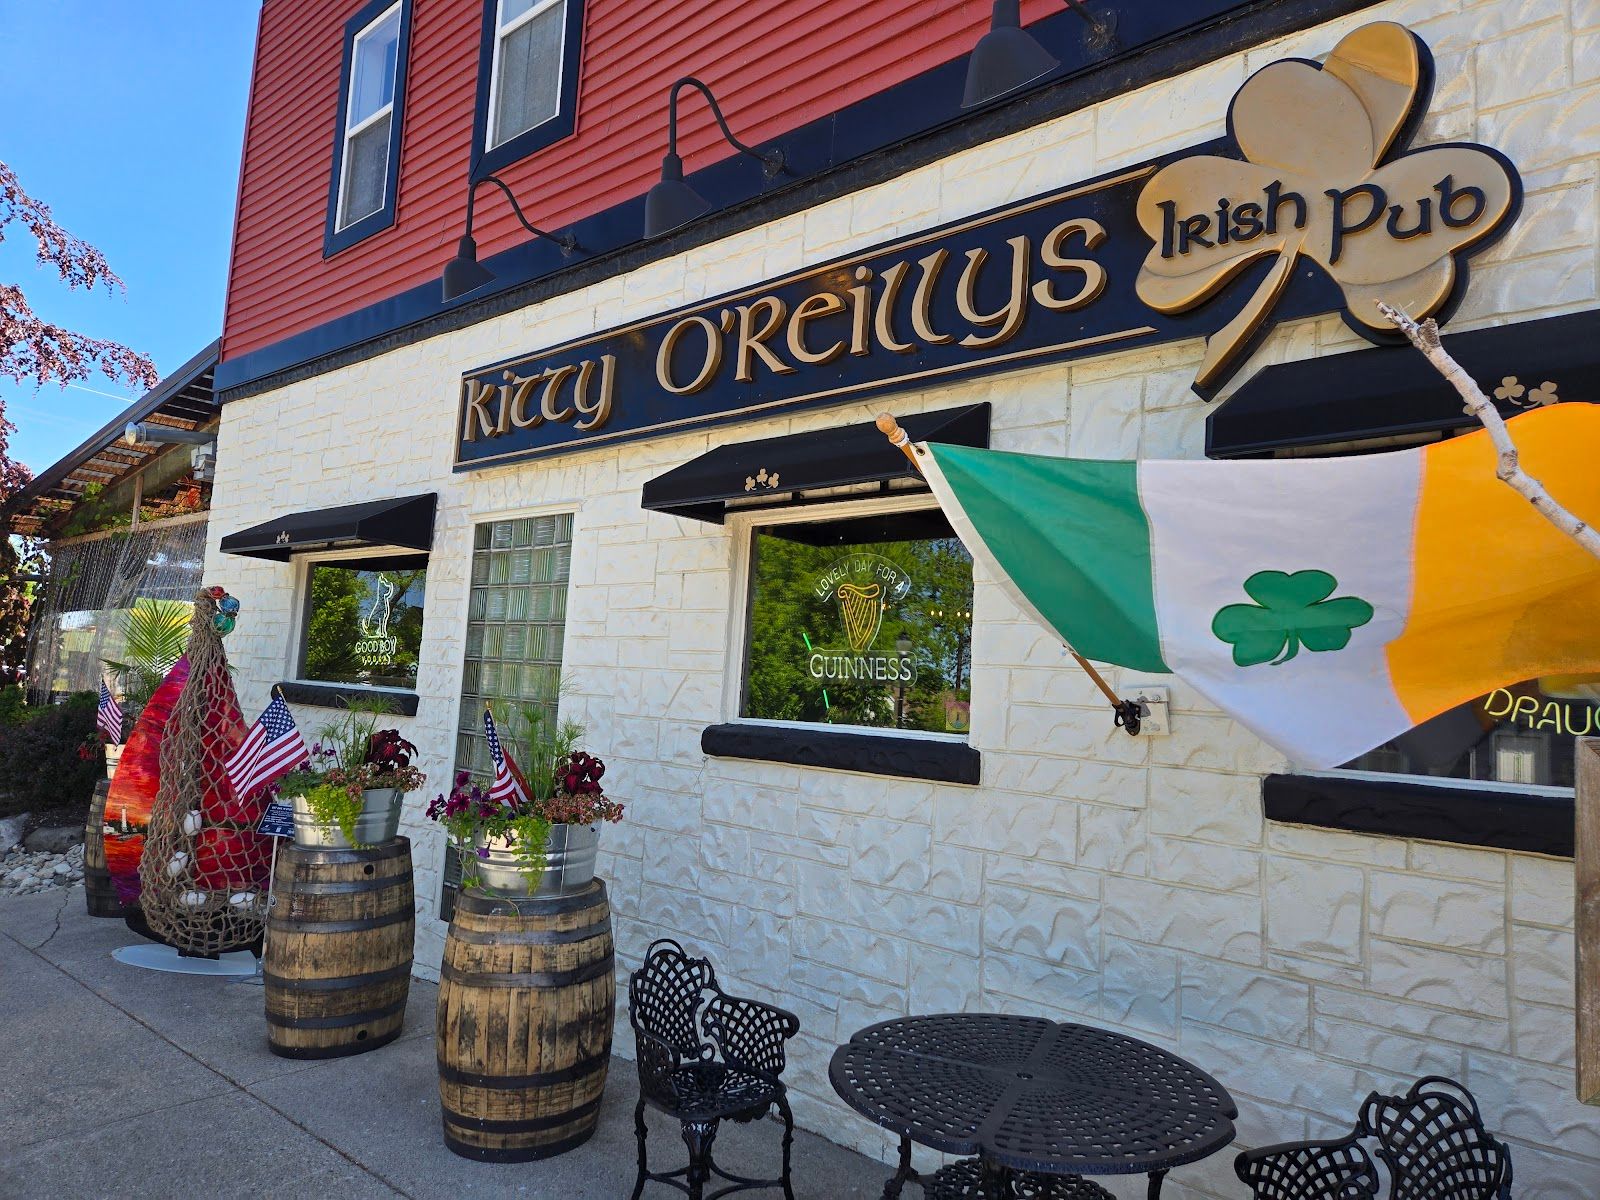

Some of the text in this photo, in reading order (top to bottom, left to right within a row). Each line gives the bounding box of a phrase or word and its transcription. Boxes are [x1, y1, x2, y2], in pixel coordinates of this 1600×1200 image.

[1156, 179, 1307, 259] Irish
[463, 217, 1108, 442] Kitty O'Reillys
[815, 559, 905, 597] LOVELY DAY FOR A
[355, 638, 395, 654] GOOD BOY
[809, 653, 912, 681] GUINNESS
[1484, 688, 1600, 736] DRAU
